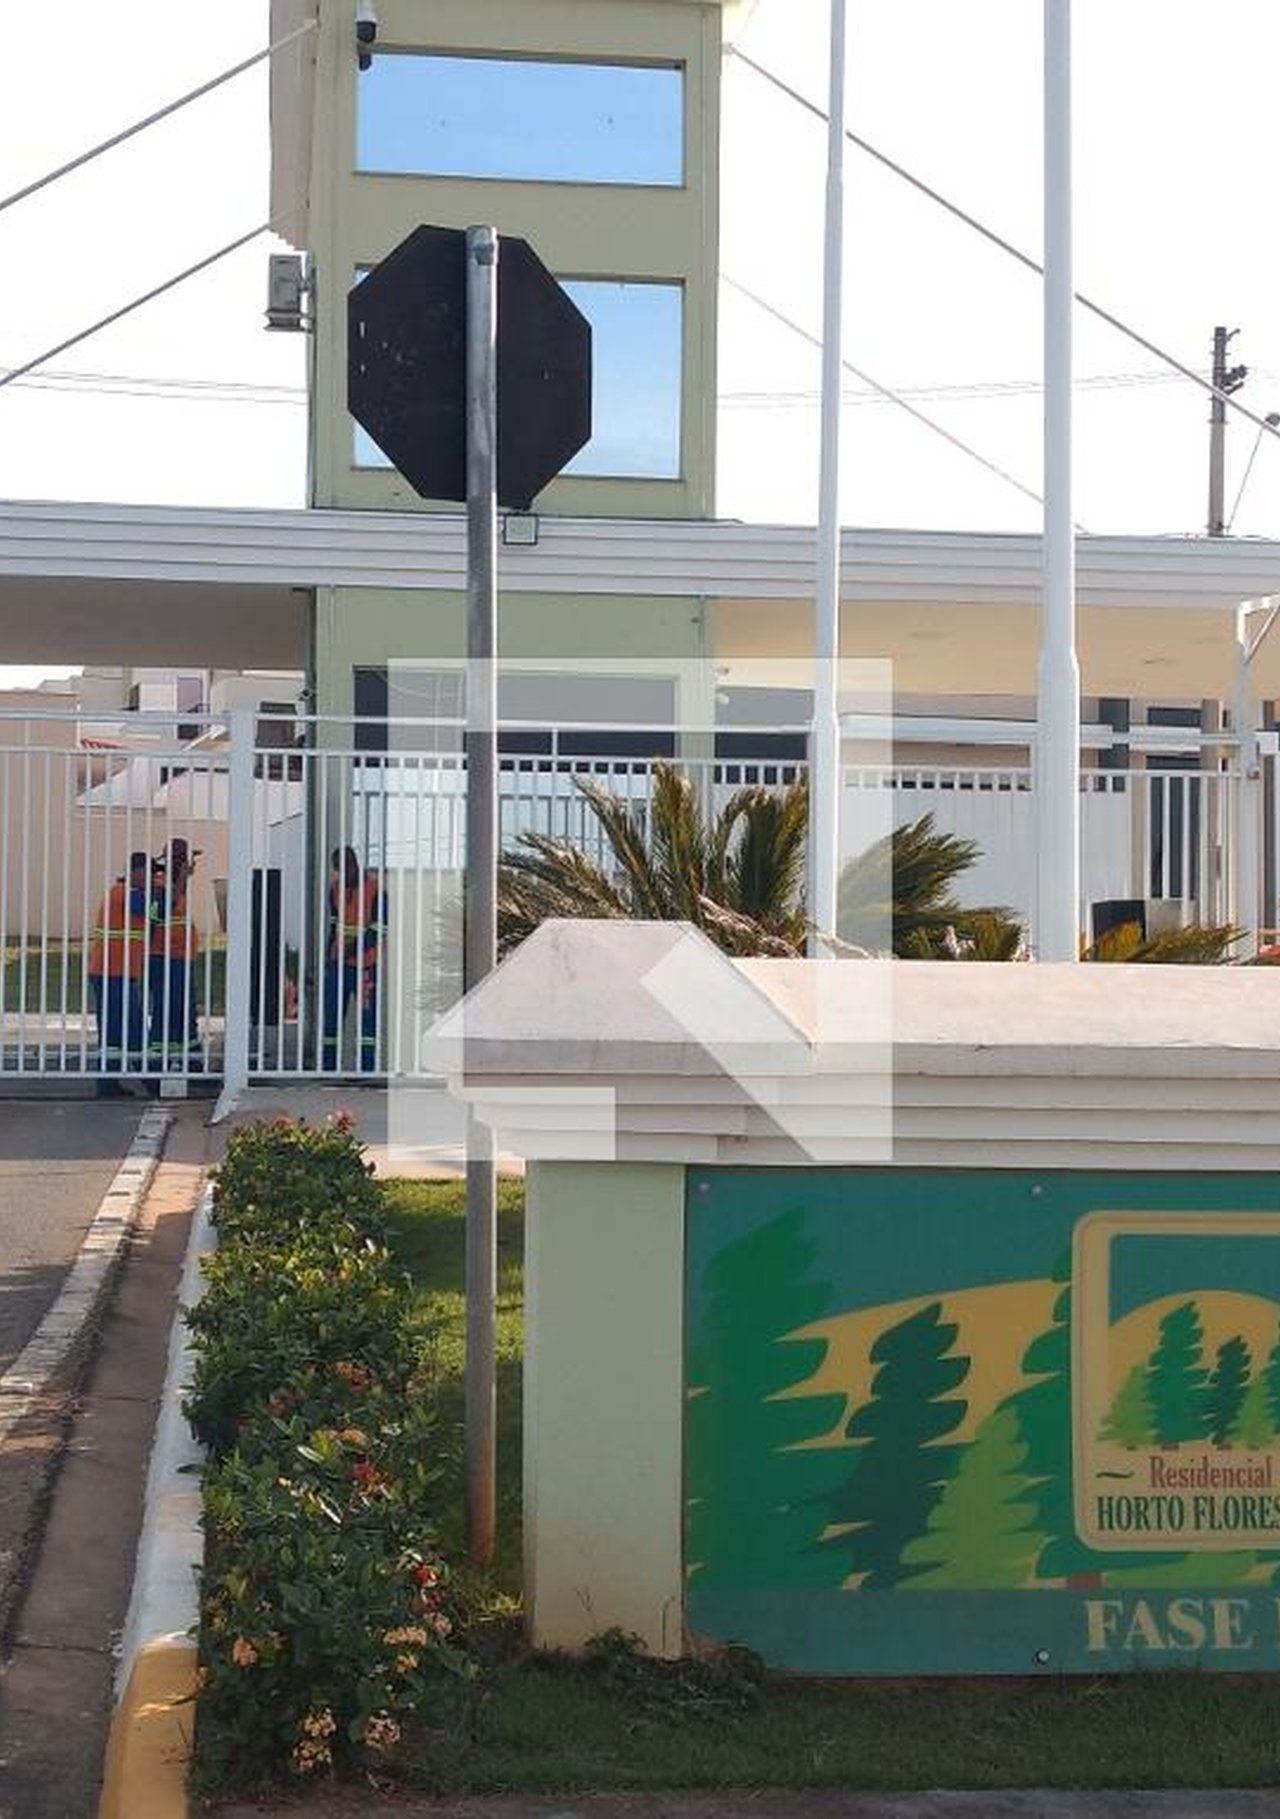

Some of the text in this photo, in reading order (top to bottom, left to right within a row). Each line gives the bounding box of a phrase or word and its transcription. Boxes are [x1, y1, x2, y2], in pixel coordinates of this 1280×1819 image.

[1148, 1456, 1273, 1489] Residencial
[1097, 1496, 1184, 1531] HORTO
[1084, 1598, 1254, 1651] FASE
